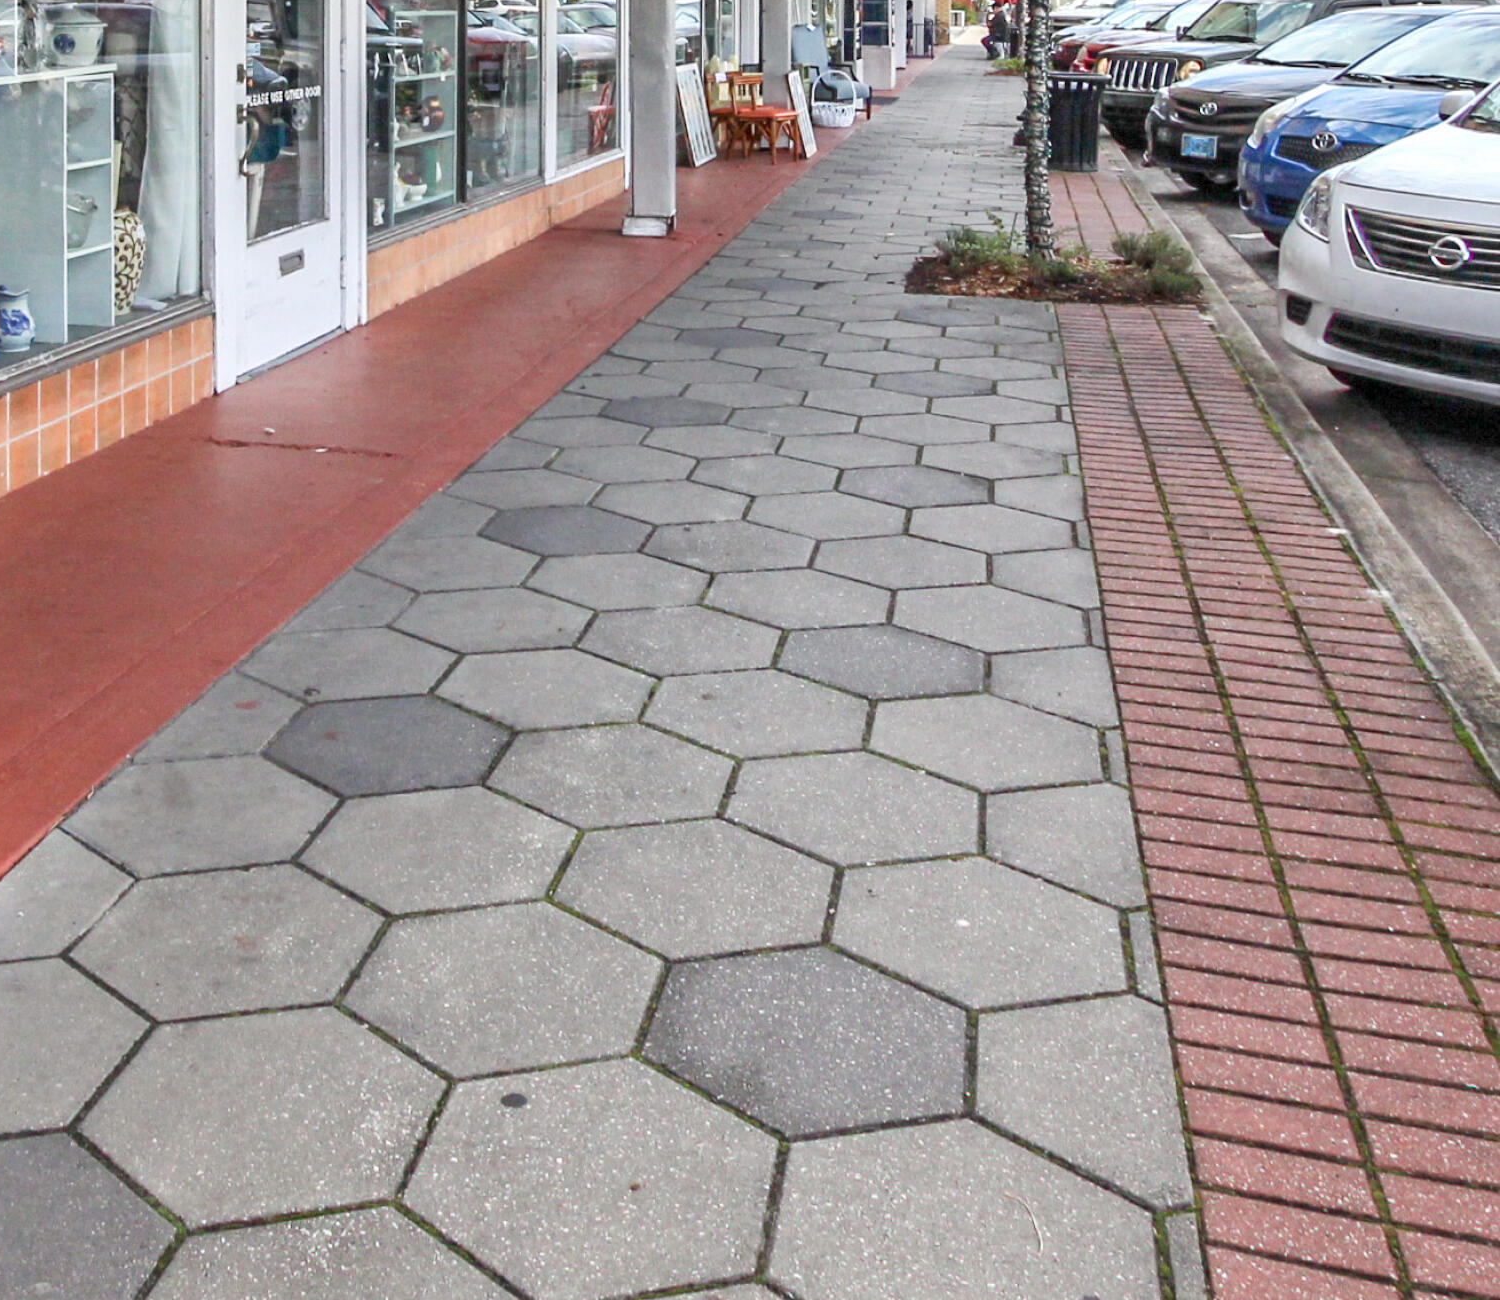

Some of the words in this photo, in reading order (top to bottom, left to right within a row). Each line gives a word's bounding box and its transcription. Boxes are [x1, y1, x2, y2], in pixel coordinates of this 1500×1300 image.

[245, 91, 269, 107] PLEASE
[270, 90, 283, 103] USE
[284, 88, 304, 100] OTHER
[305, 85, 322, 98] DOOR
